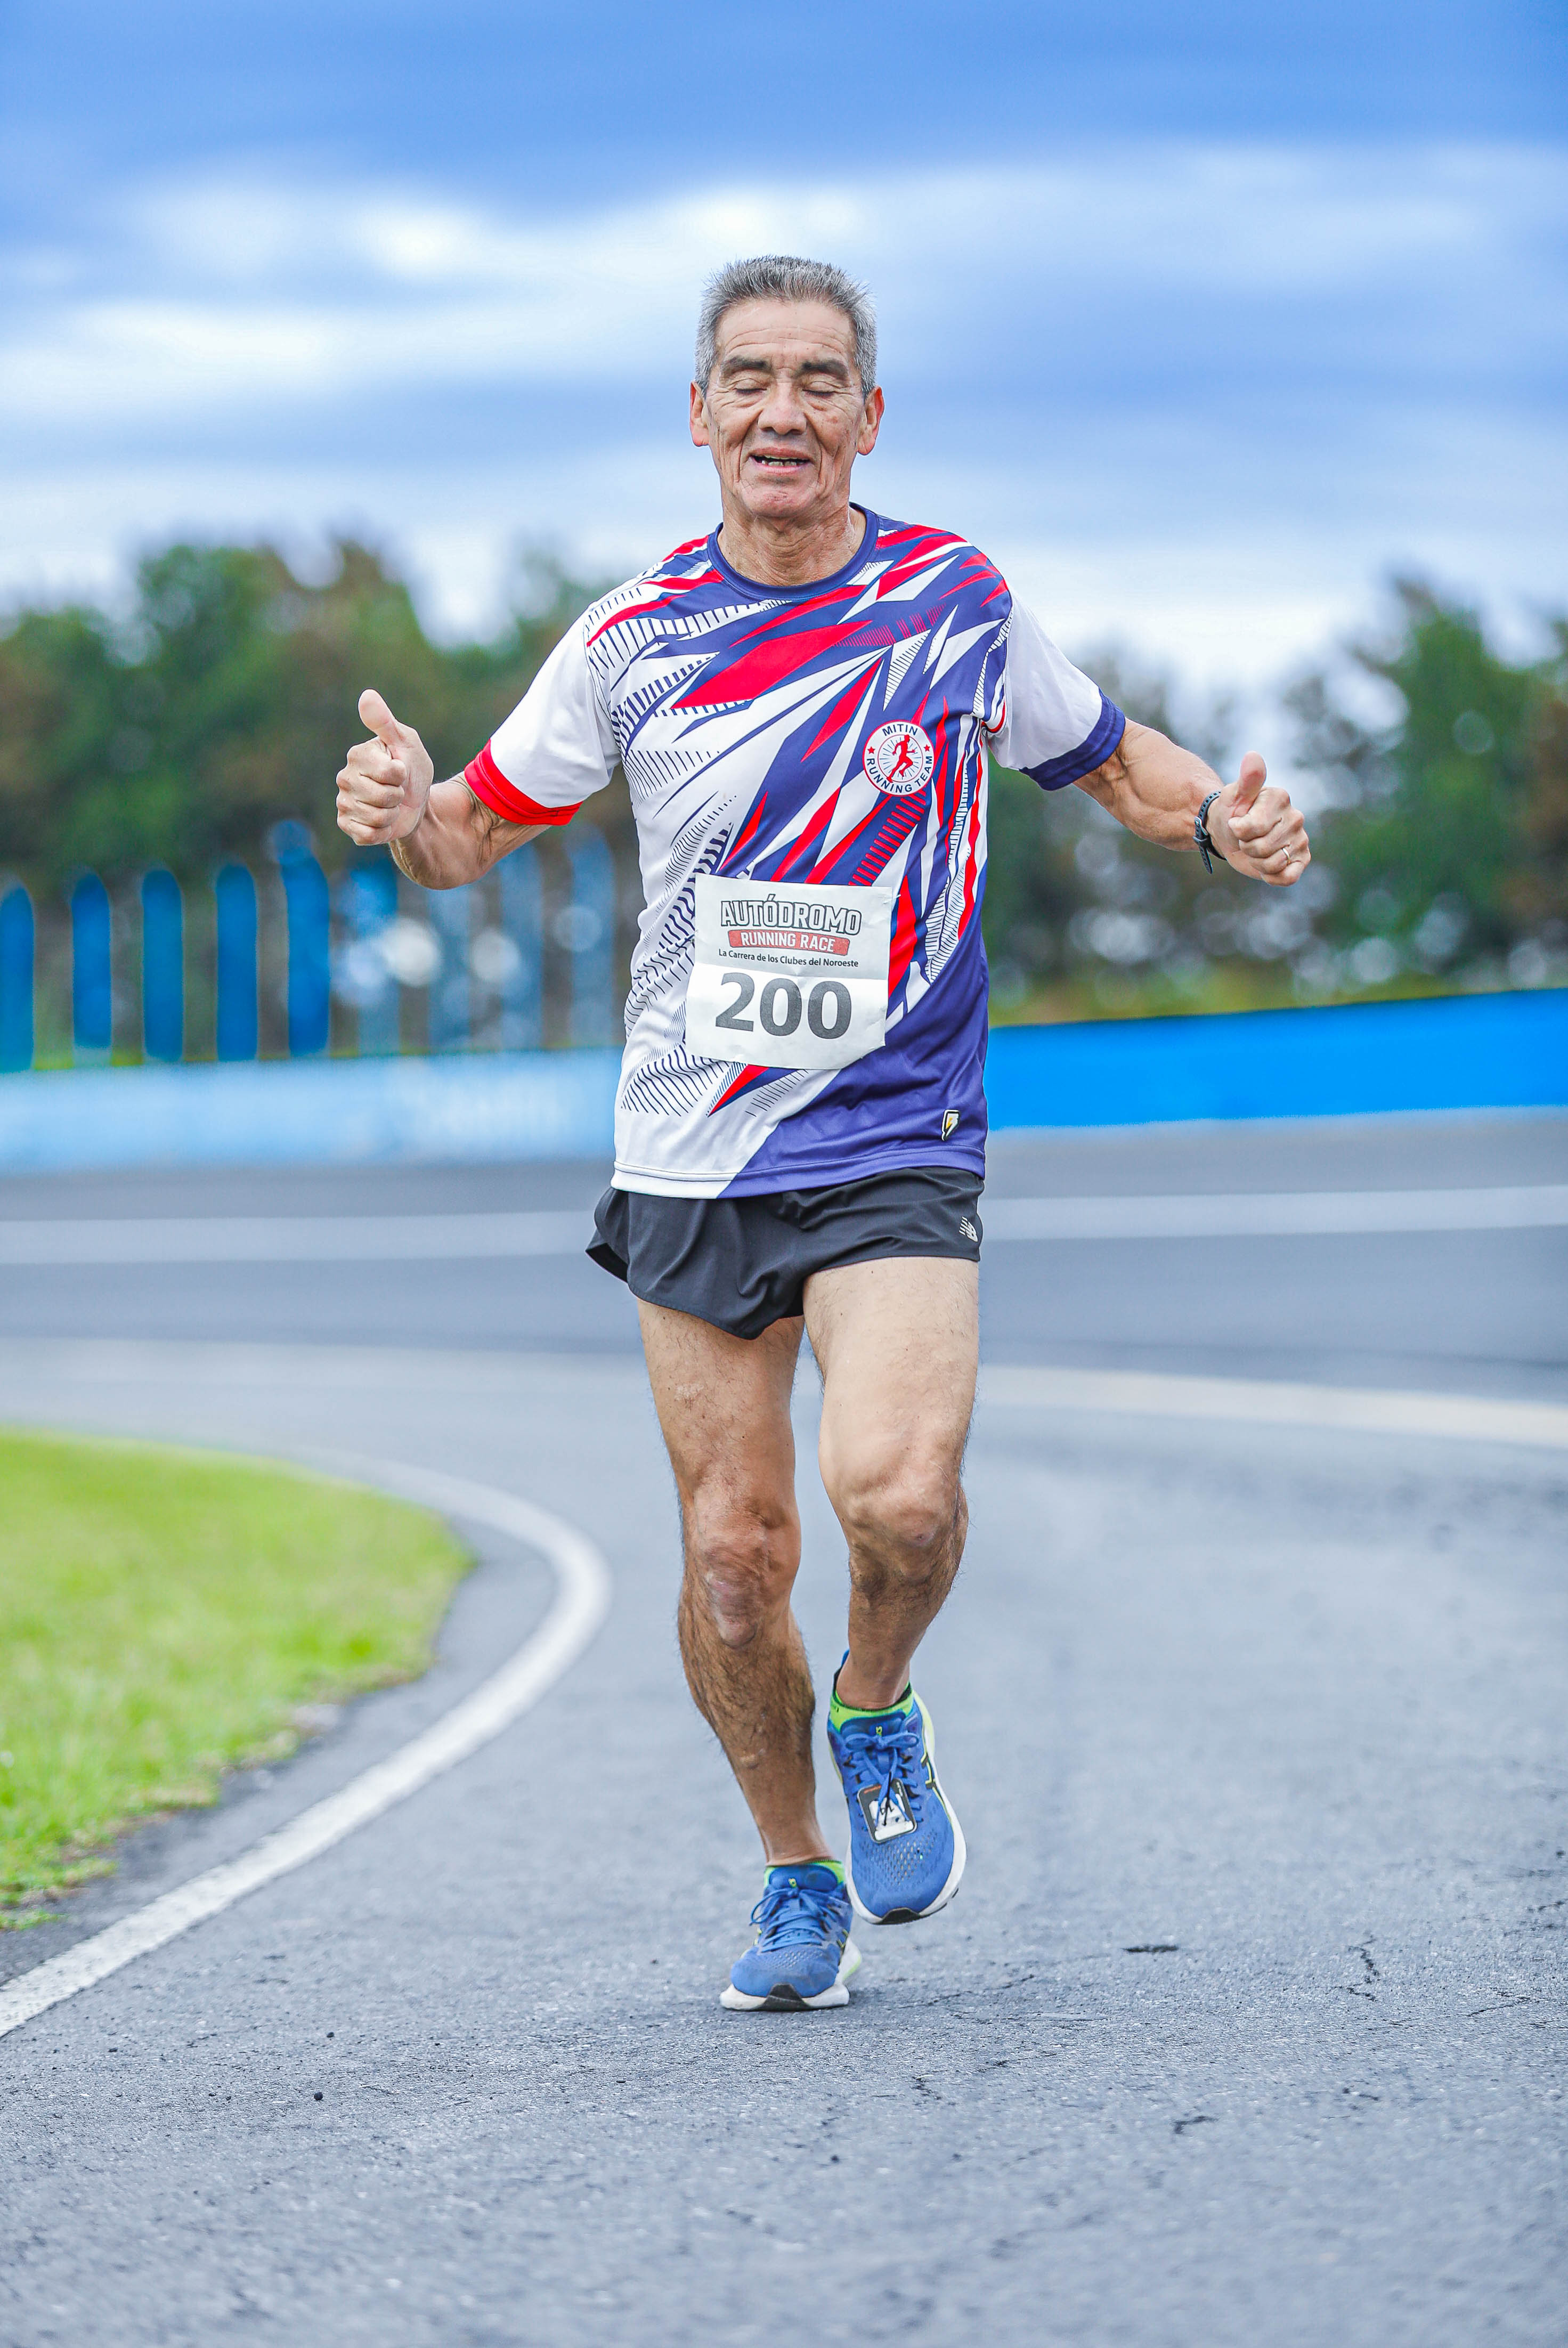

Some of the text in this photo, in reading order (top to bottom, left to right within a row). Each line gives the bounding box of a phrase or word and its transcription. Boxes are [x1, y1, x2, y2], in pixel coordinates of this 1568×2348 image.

[882, 724, 918, 736] MITIN
[866, 755, 933, 793] RUNNING TEAM
[720, 893, 862, 936] AUTÓDROMO
[740, 932, 836, 953] RUNNING RACE
[728, 950, 755, 960] Carrera
[757, 953, 766, 962] de
[768, 954, 778, 963] los
[780, 956, 807, 965] Clubes
[823, 958, 859, 967] Noroeste
[715, 972, 852, 1039] 200
